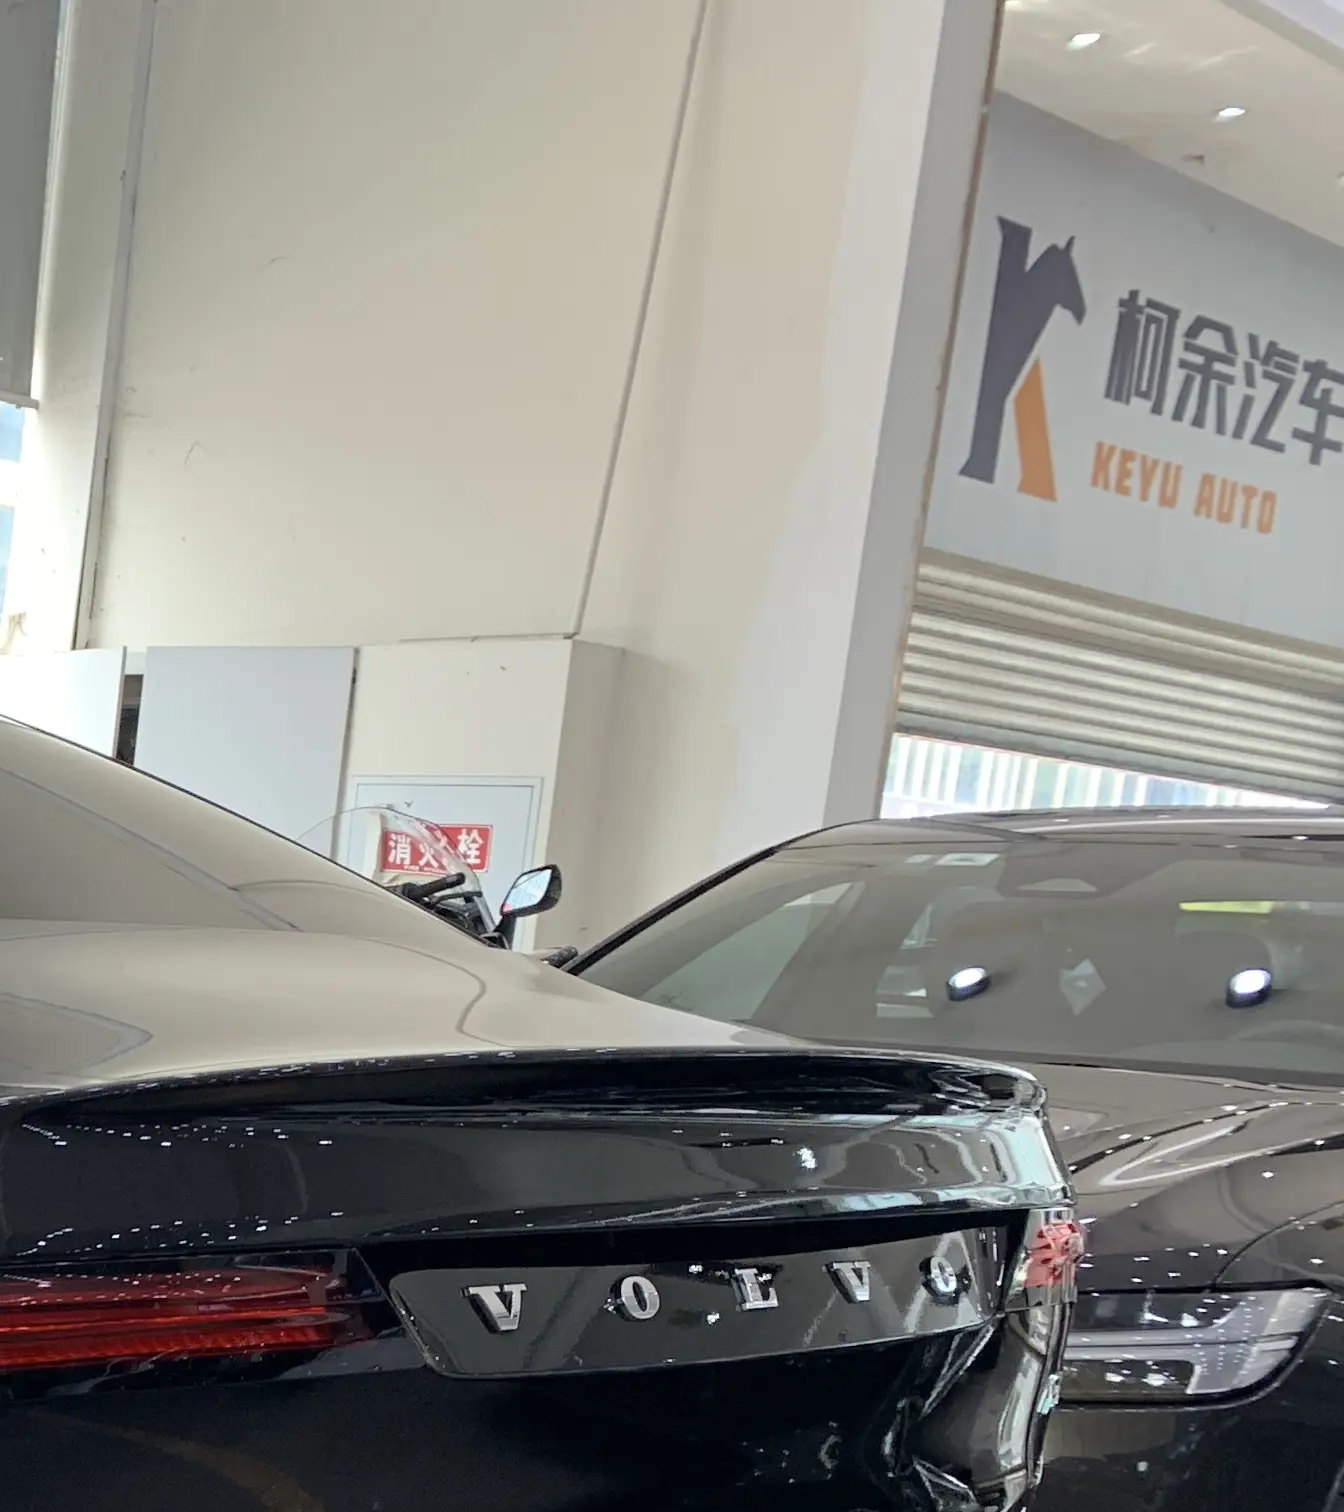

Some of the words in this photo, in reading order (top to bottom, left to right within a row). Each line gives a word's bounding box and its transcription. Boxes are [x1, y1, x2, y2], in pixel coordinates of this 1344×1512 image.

[1104, 289, 1344, 467] 柯余汽车
[1090, 441, 1184, 509] KEYU
[1193, 472, 1278, 535] AUTO
[388, 828, 484, 869] 消火栓
[462, 1255, 966, 1334] VOLVO
